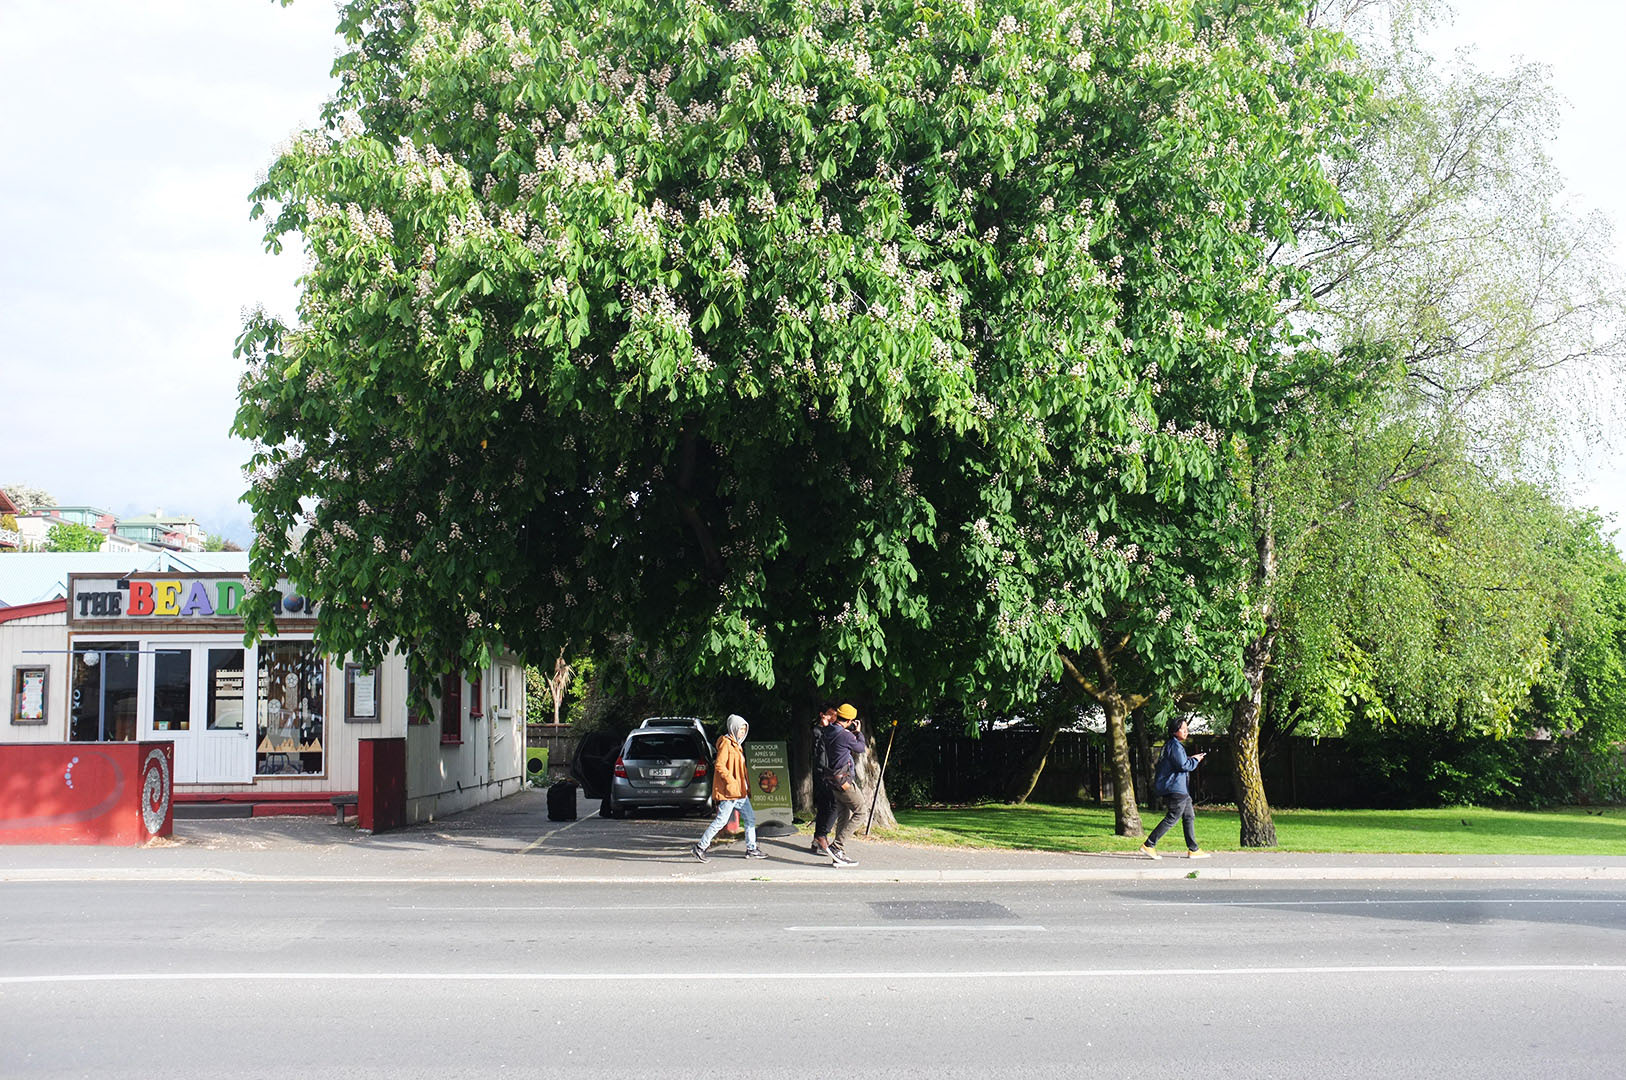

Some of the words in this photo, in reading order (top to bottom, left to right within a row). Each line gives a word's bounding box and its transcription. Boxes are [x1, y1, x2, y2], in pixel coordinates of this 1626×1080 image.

[77, 591, 122, 616] THE
[126, 580, 247, 616] BEAD
[753, 794, 766, 802] 0800
[767, 794, 774, 802] 42
[775, 794, 787, 802] 6161
